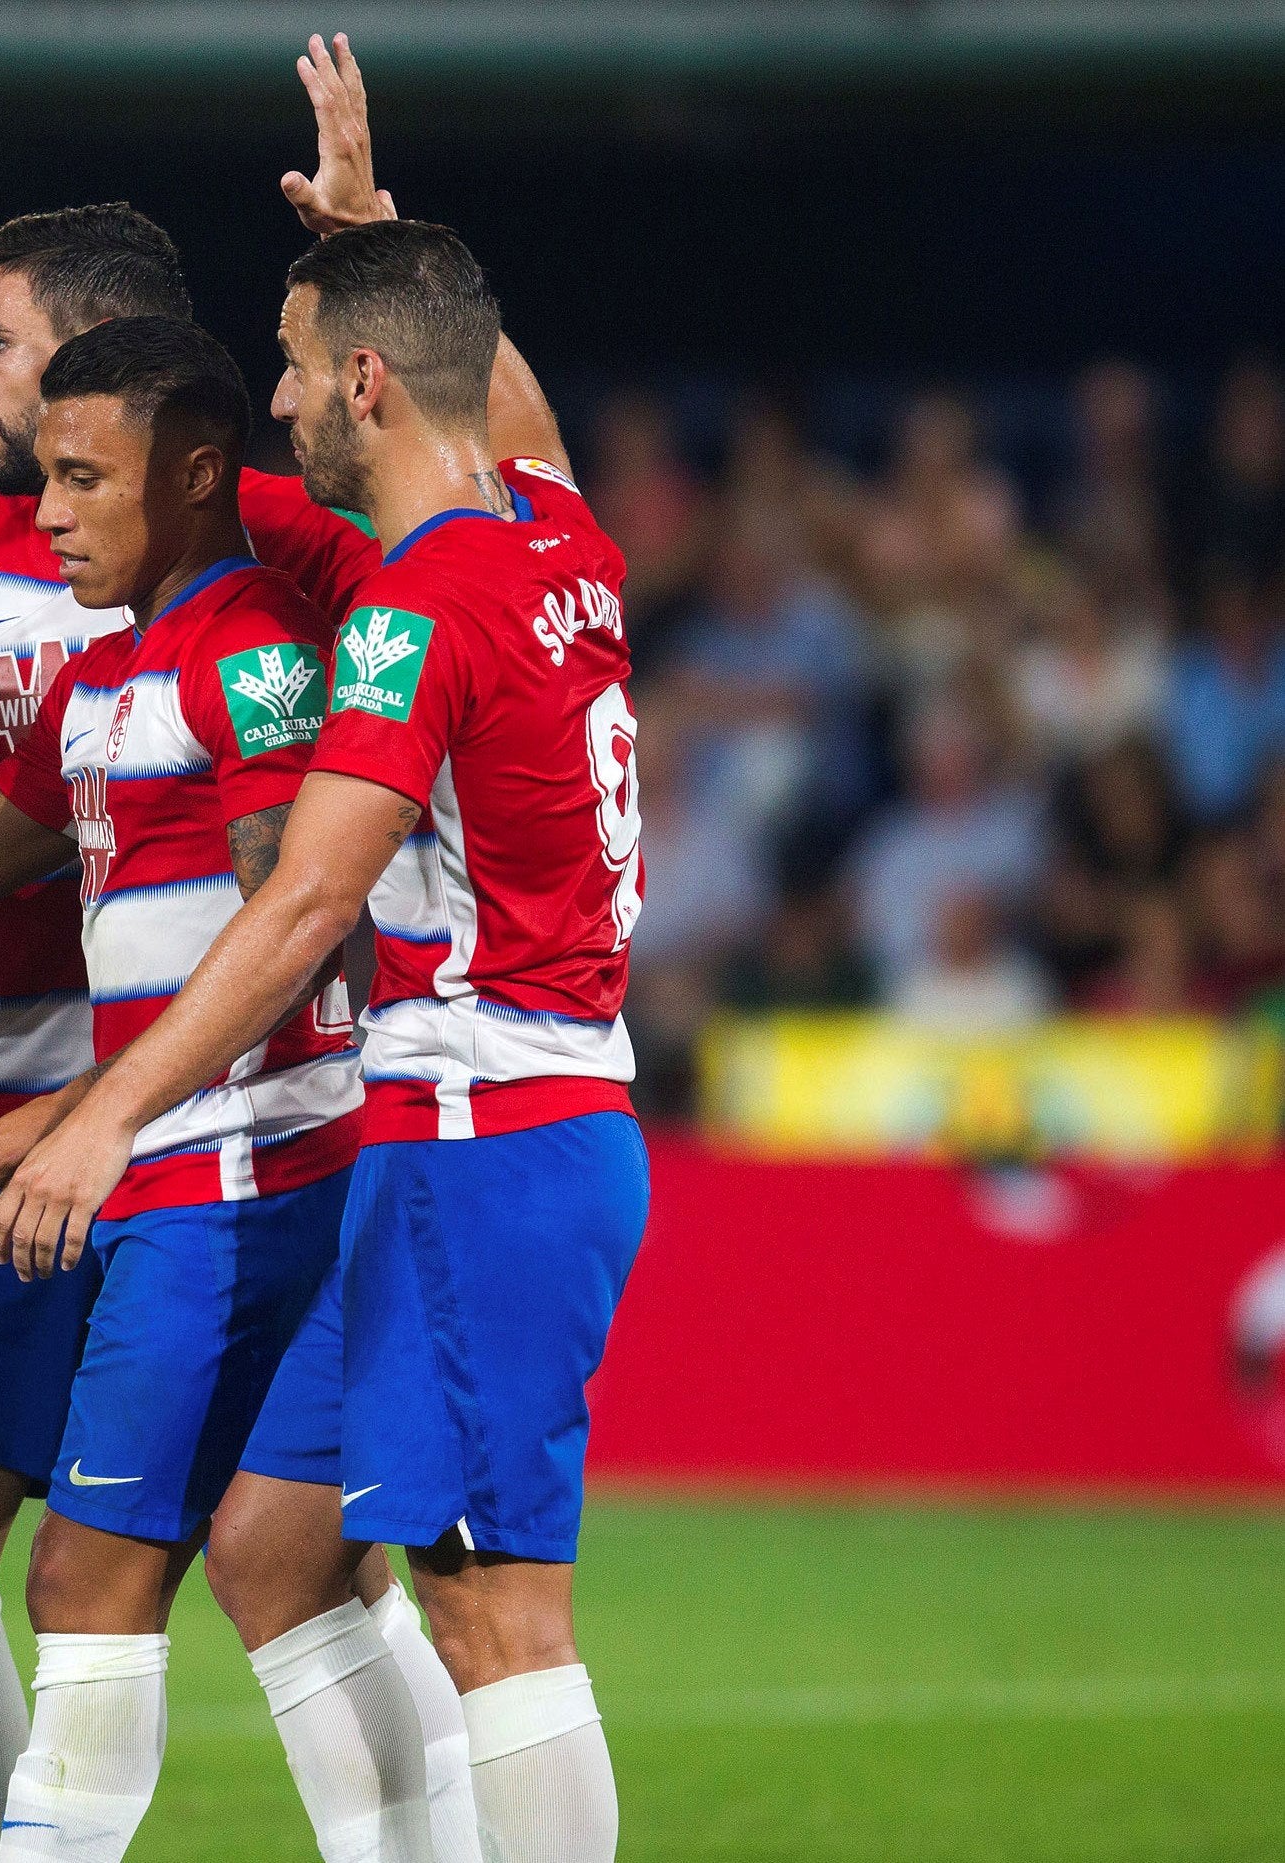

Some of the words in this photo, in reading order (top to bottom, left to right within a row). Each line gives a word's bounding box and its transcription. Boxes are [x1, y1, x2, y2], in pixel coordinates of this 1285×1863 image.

[354, 682, 405, 708] RURAL
[243, 722, 280, 743] CAJA
[264, 731, 313, 748] GRANADA
